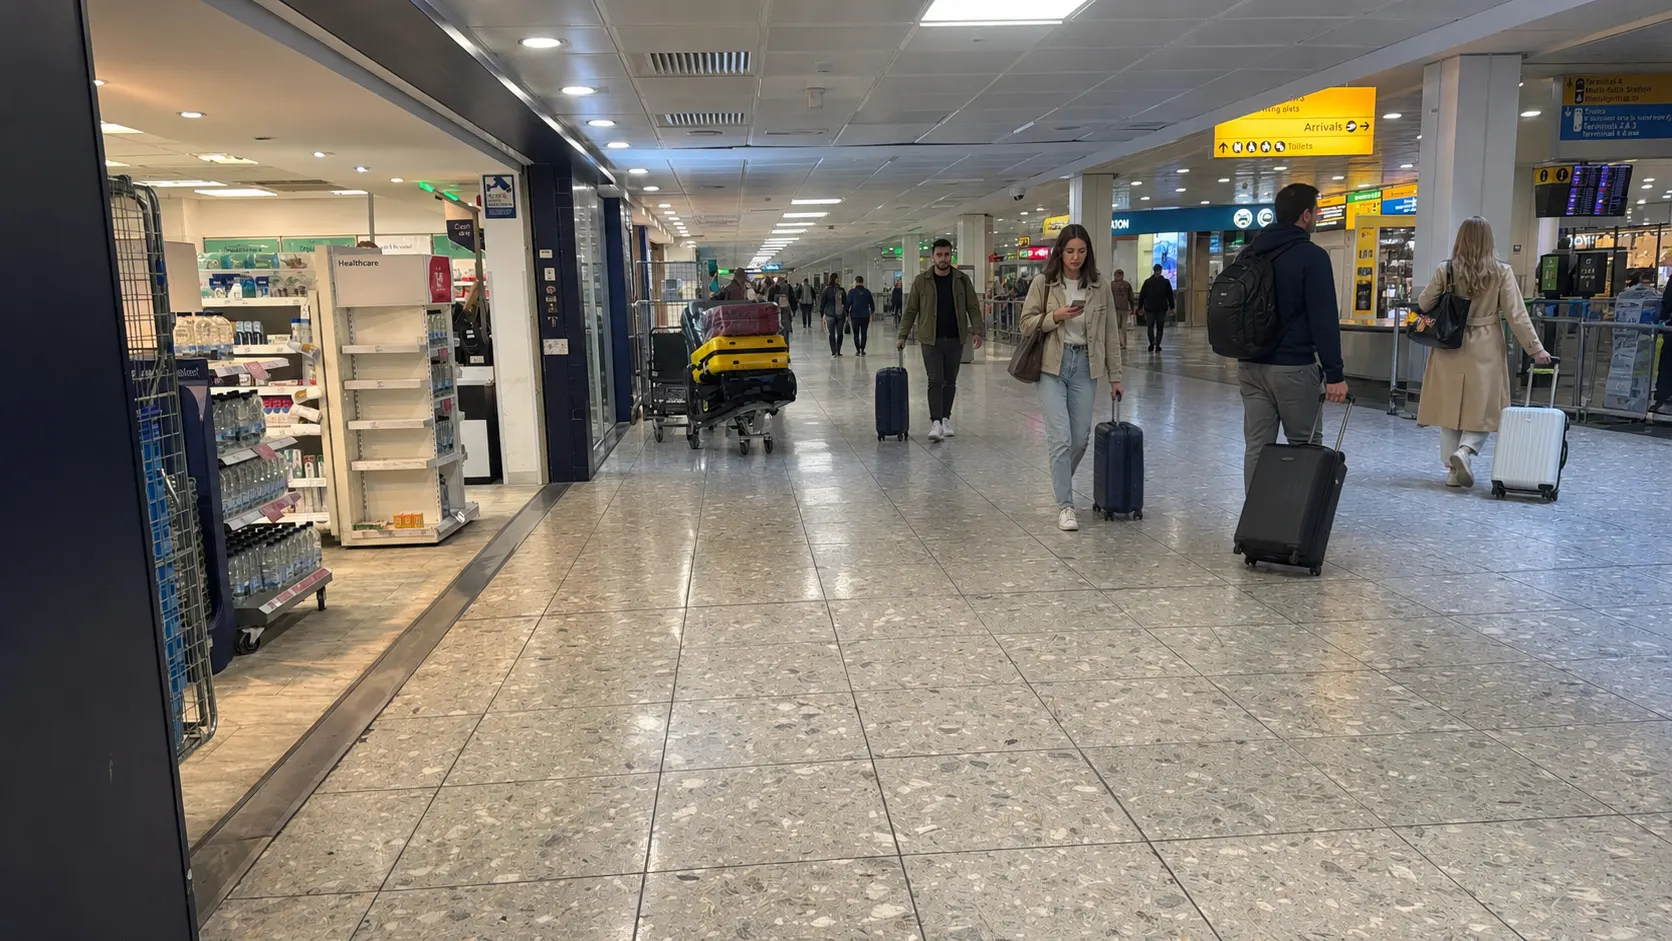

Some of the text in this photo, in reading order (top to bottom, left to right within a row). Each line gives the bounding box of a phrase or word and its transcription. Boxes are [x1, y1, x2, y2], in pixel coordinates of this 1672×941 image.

[1304, 122, 1342, 132] Arrivals
[1288, 142, 1313, 150] Toilets
[338, 259, 379, 267] Healthcare
